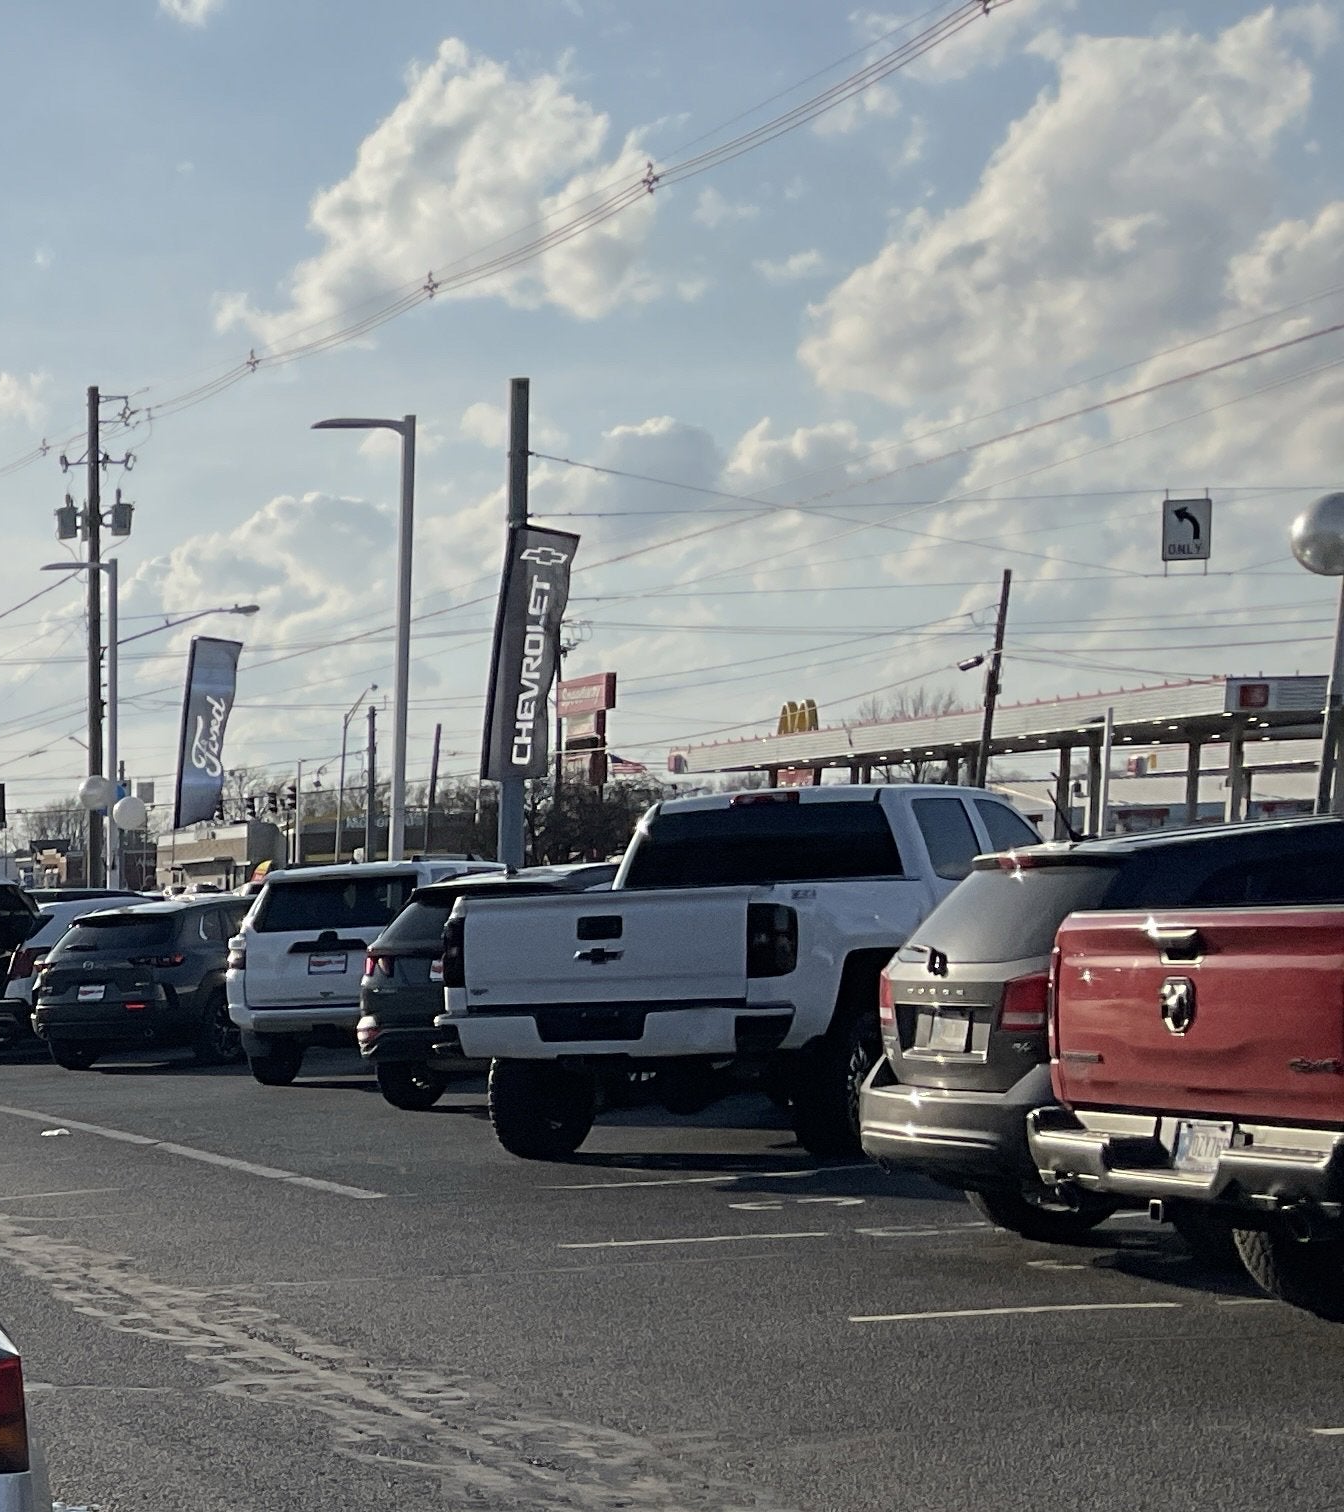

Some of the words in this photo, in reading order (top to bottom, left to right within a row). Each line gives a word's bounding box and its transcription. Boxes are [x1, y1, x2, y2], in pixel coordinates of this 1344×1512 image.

[1167, 543, 1203, 555] ONLY
[511, 574, 551, 765] CHEVROLET
[192, 695, 226, 777] Ford
